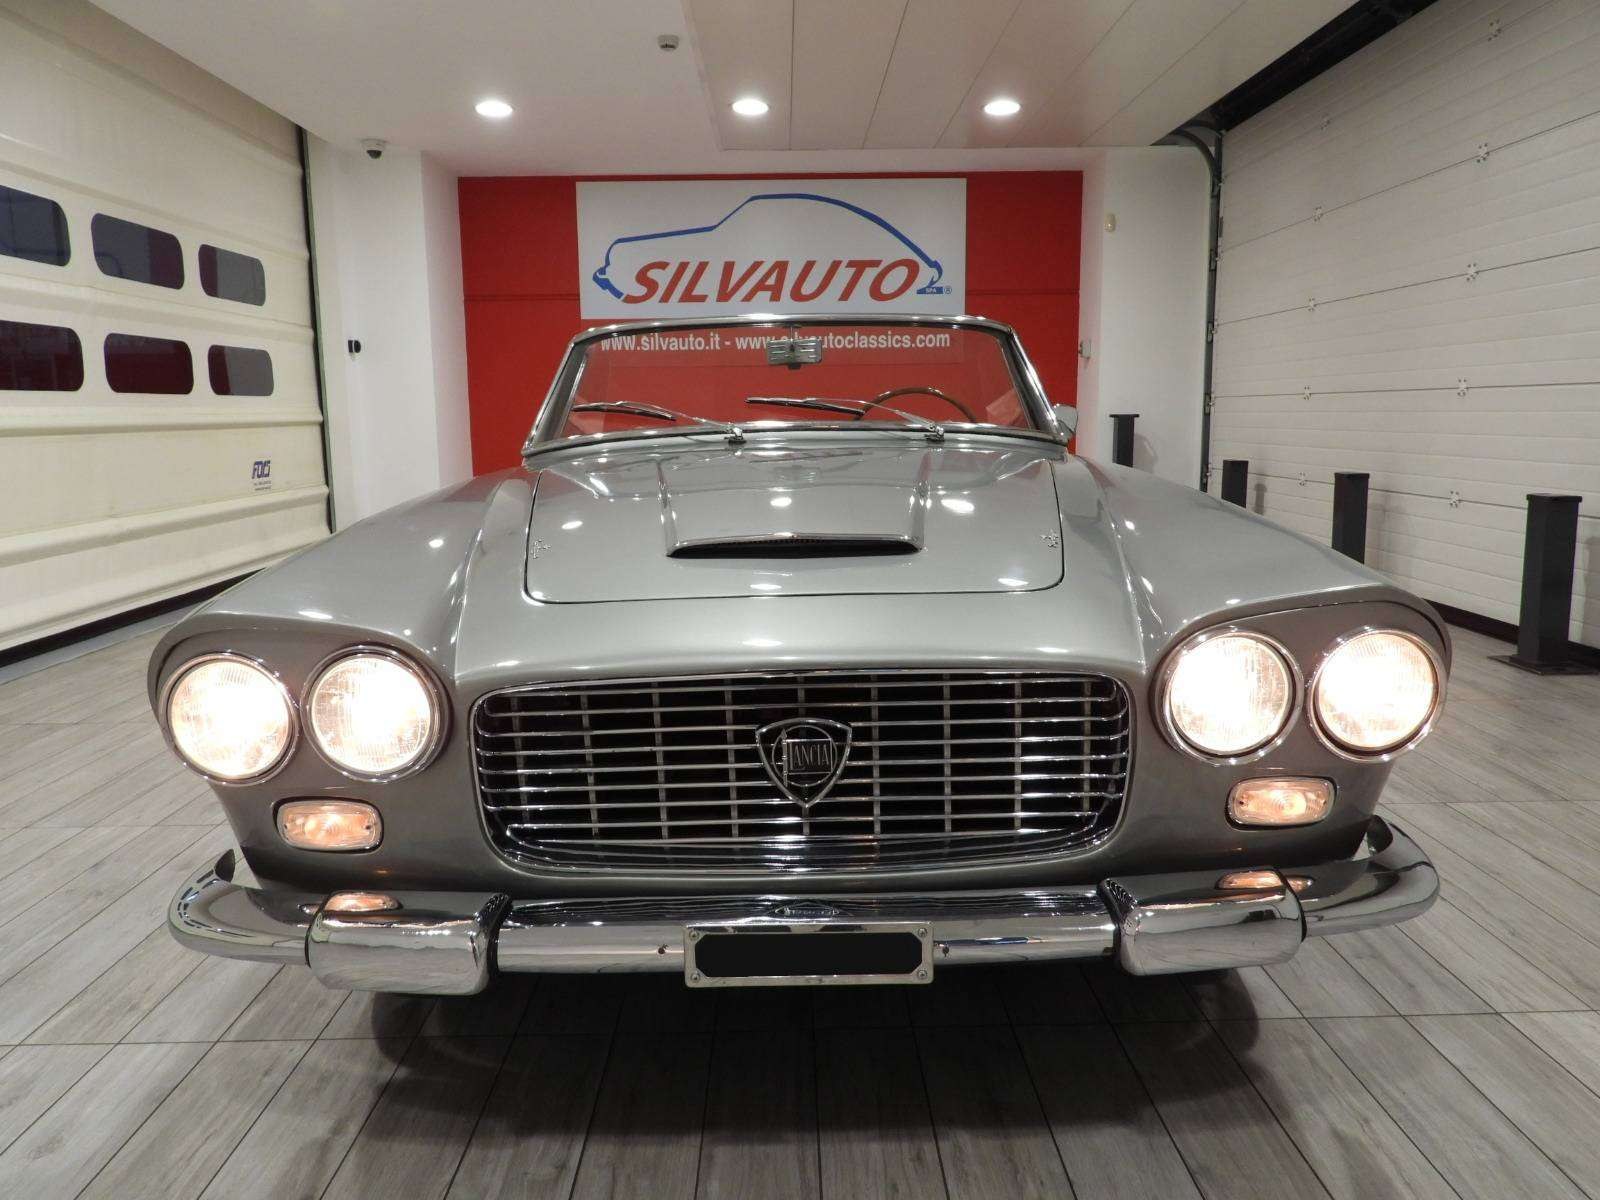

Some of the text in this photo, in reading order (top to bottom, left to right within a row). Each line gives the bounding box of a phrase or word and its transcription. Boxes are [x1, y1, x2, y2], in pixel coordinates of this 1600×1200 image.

[622, 258, 920, 304] SILVAUTO
[601, 332, 720, 351] www.silvauto.it
[735, 331, 950, 350] wwutoclassics.com
[789, 743, 830, 771] LANCIA
